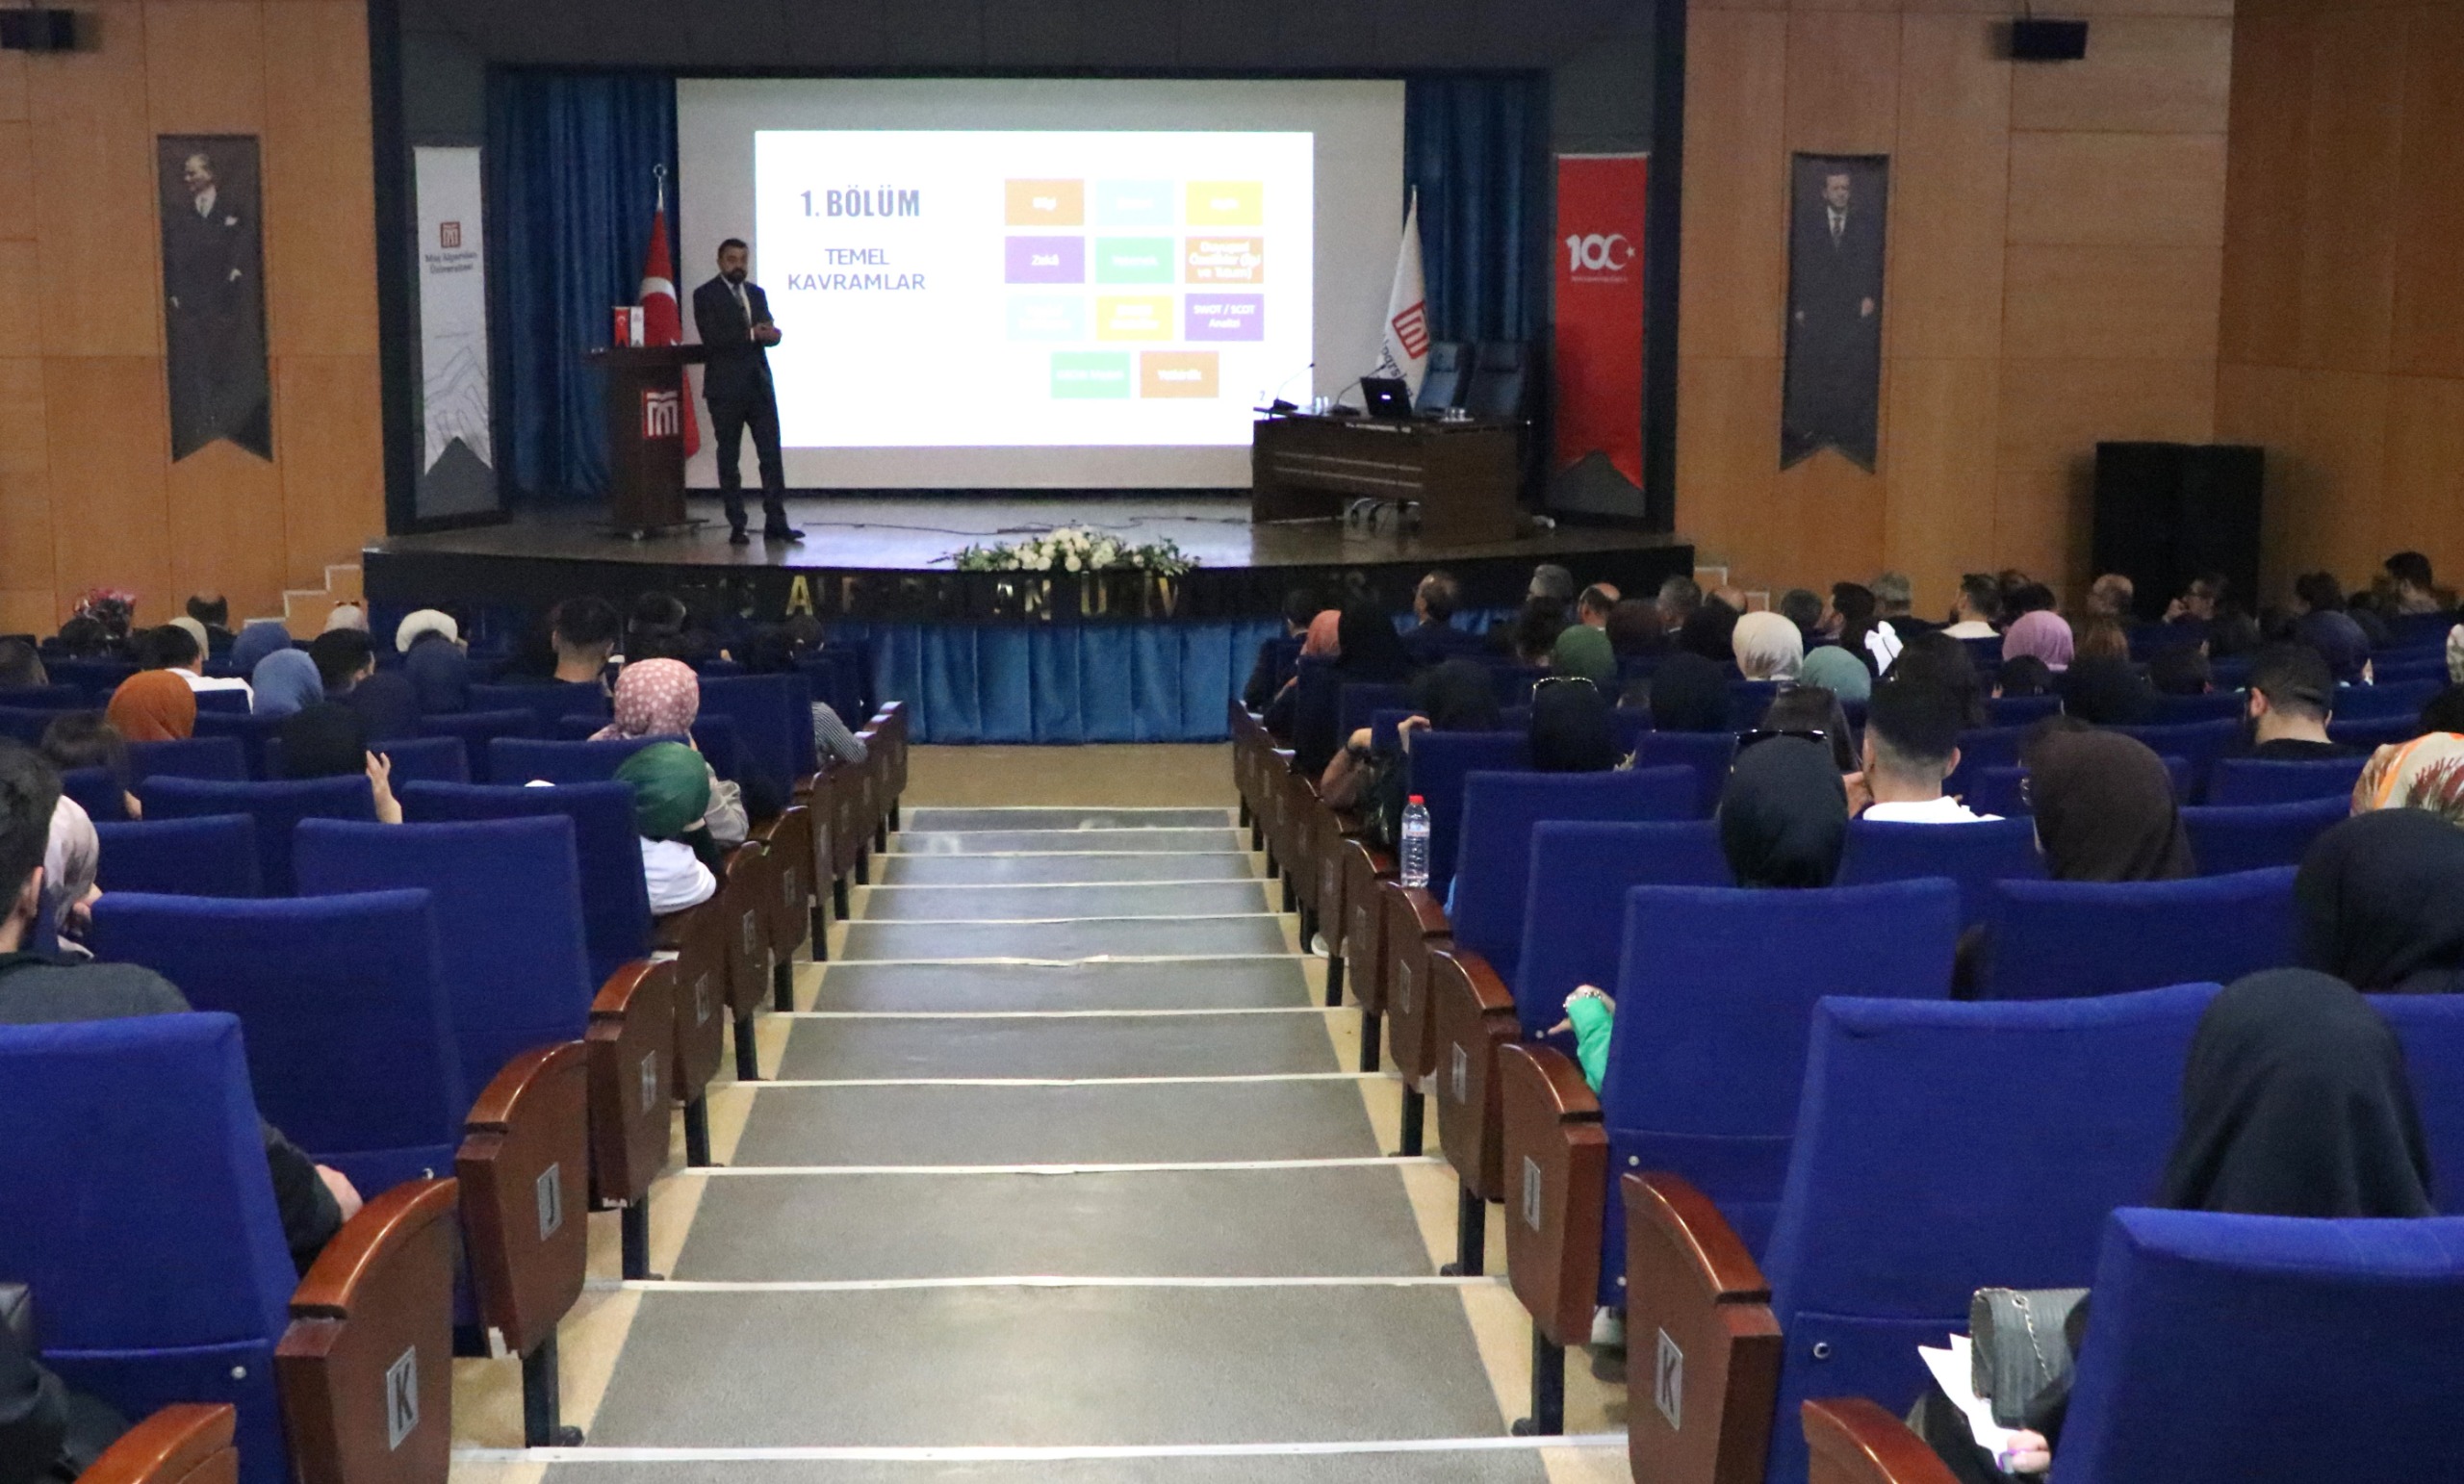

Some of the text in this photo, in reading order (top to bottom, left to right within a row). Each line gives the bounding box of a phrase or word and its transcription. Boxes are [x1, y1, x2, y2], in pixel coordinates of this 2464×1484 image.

[801, 184, 920, 217] 1. BÖLÜM
[824, 247, 890, 266] TEMEL
[787, 273, 926, 291] KAVRAMLAR
[395, 1362, 414, 1431] K
[1661, 1344, 1676, 1416] K
